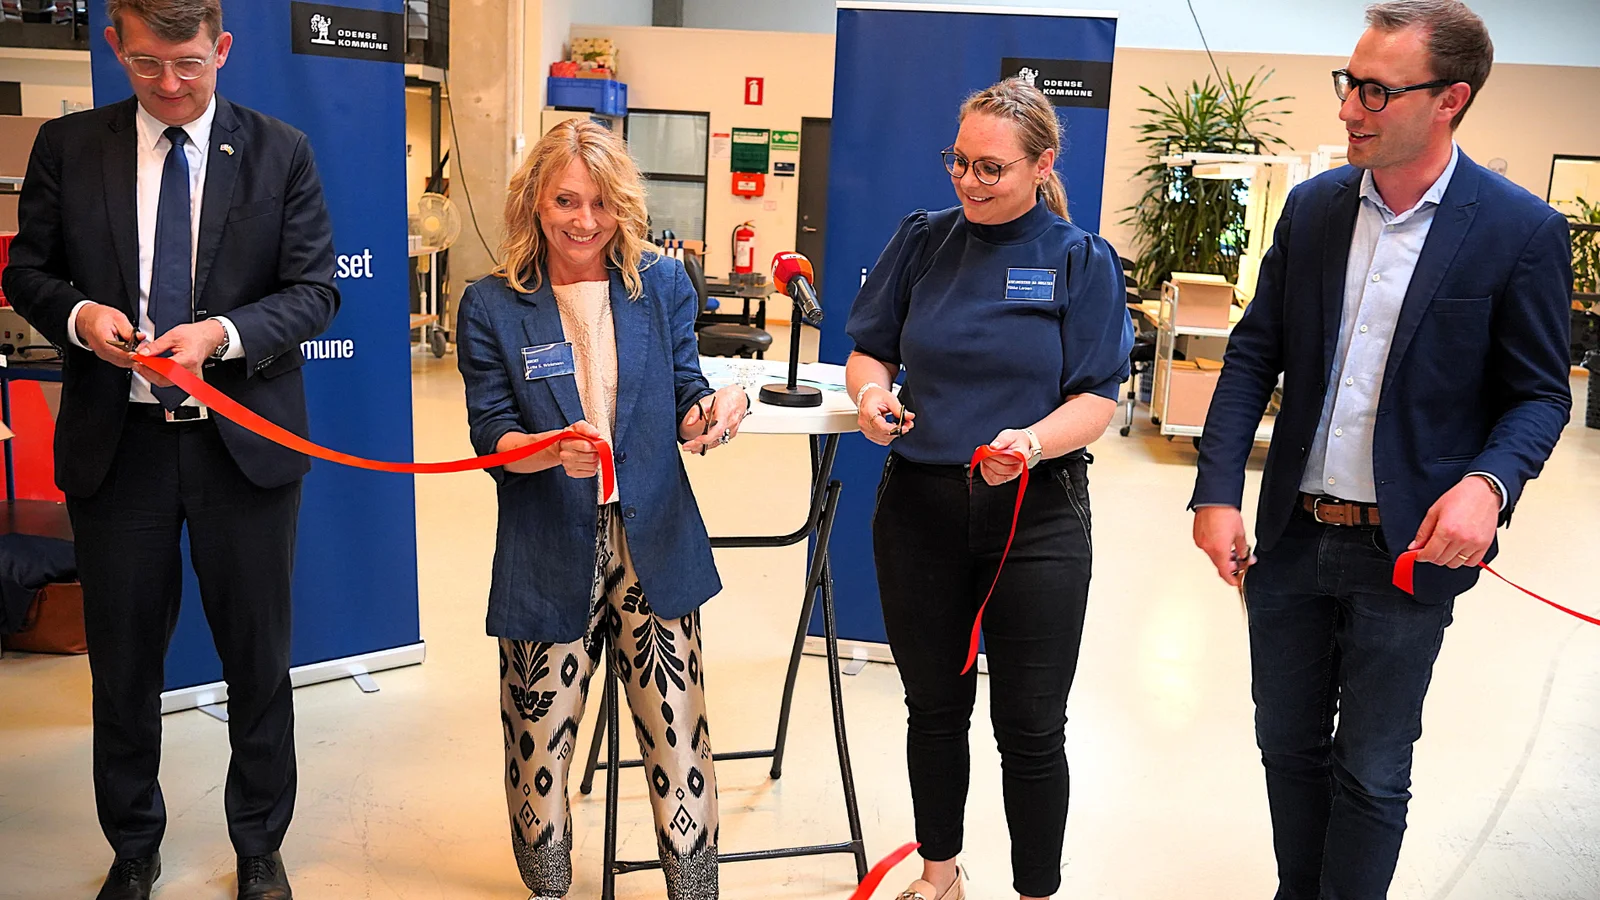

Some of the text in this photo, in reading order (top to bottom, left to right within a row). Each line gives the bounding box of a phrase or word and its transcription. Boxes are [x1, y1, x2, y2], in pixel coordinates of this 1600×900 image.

[337, 29, 378, 40] ODENSE
[338, 39, 388, 51] KOMMUNE
[1043, 79, 1083, 88] ODENSE
[1043, 88, 1093, 97] KOMMUNE
[333, 248, 374, 278] set
